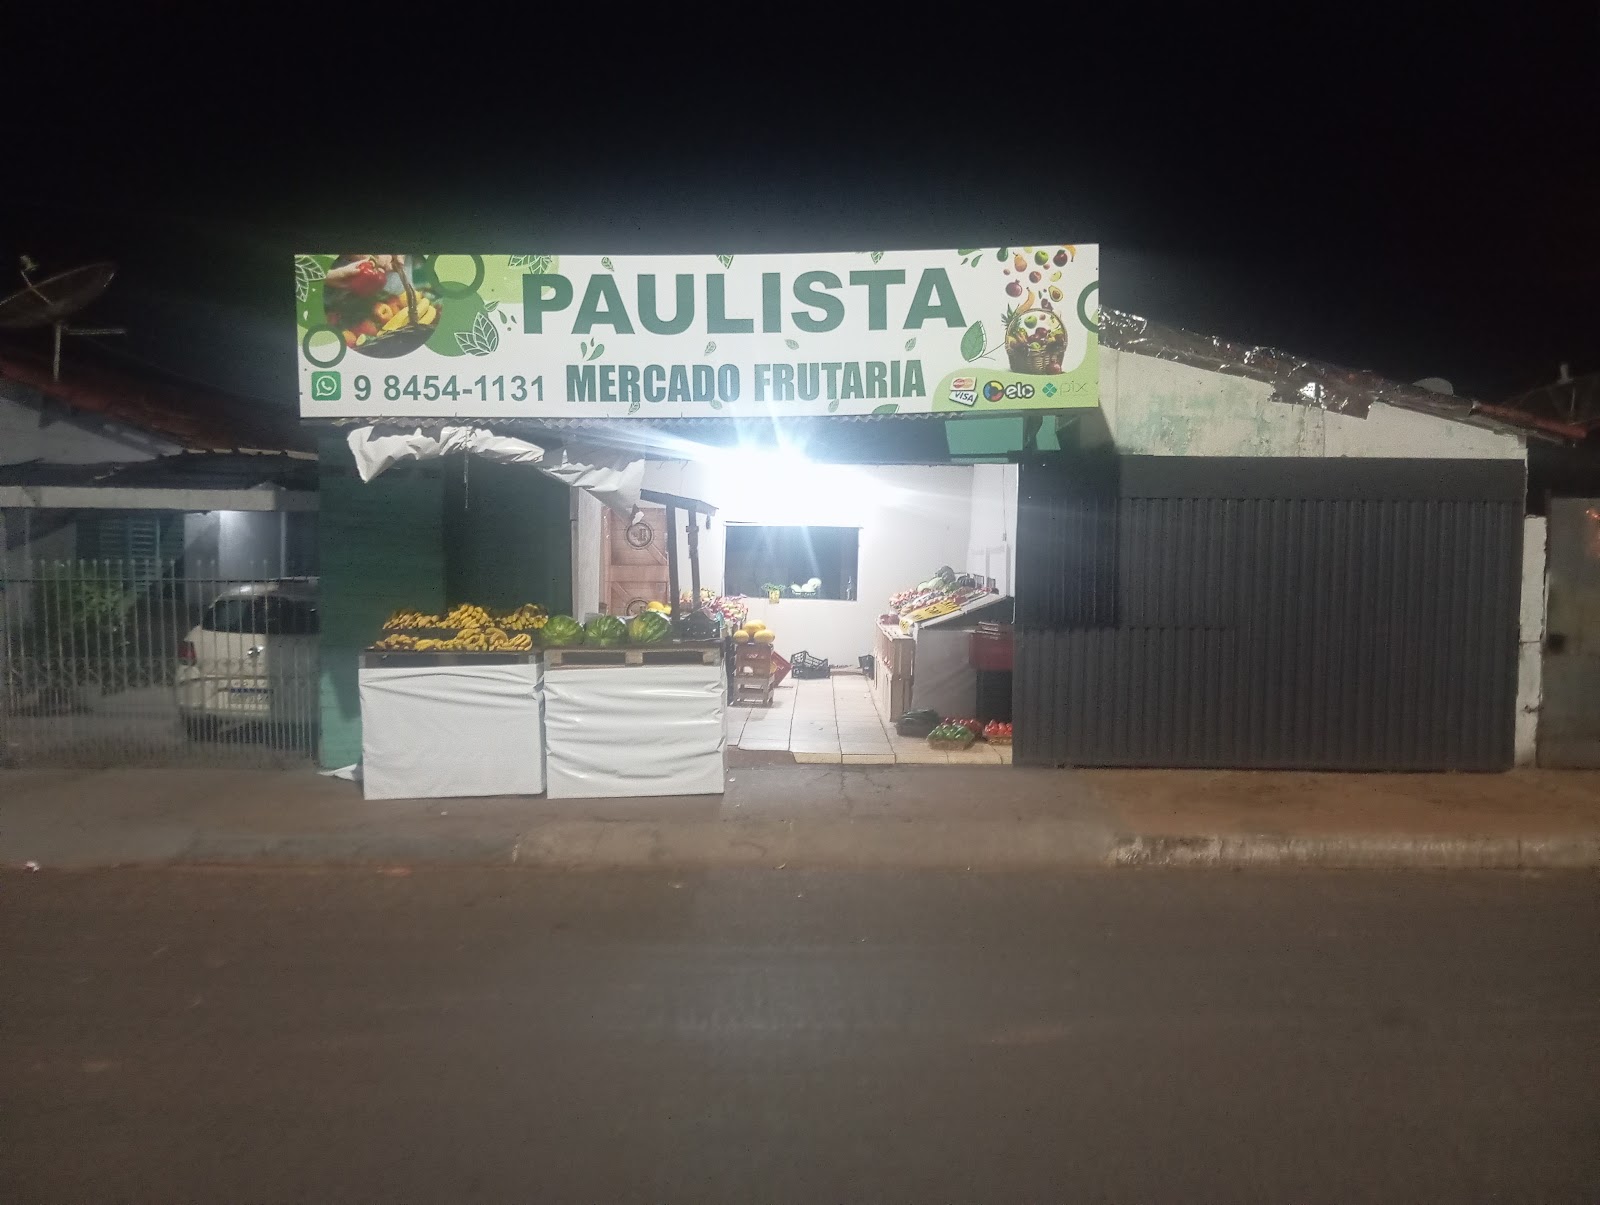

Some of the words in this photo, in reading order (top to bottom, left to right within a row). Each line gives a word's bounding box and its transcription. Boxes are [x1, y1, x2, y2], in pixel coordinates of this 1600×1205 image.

[523, 268, 966, 335] PAULISTA
[353, 375, 372, 401] 9
[384, 375, 544, 402] 8454-1131
[566, 364, 740, 402] MERCADO
[754, 360, 926, 402] FRUTARIA
[1060, 380, 1088, 396] pix
[954, 391, 974, 402] VISA
